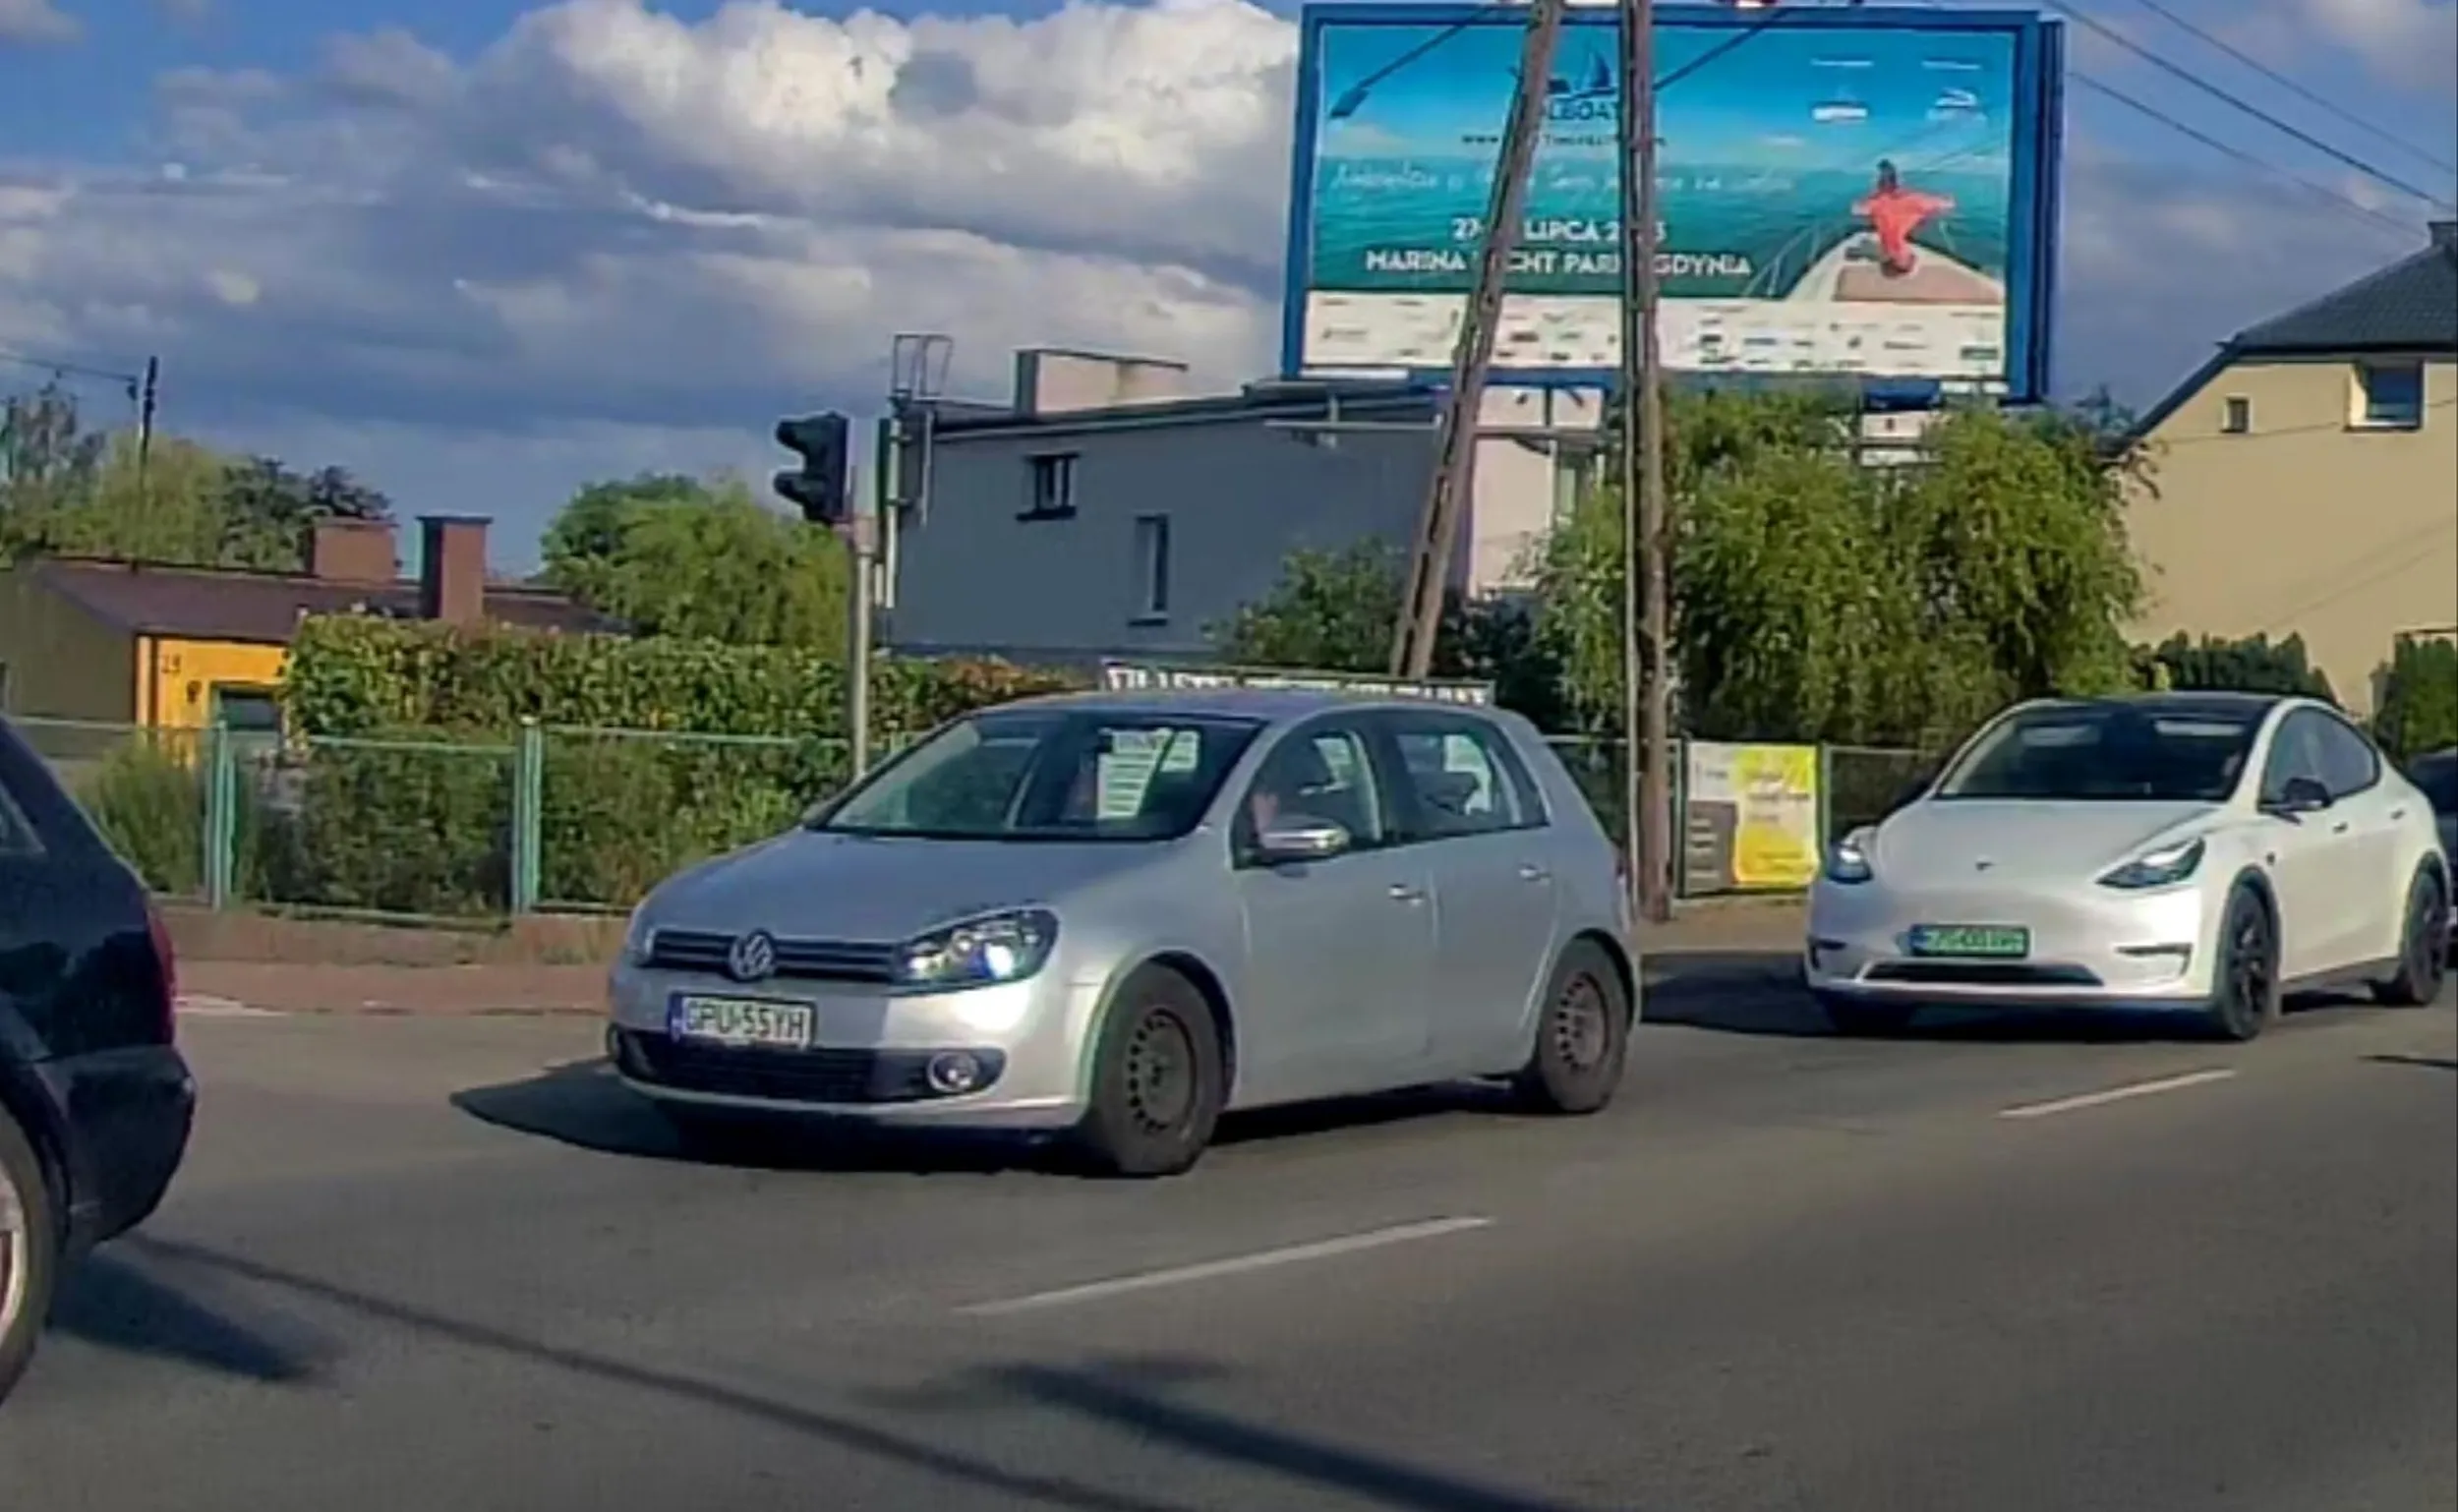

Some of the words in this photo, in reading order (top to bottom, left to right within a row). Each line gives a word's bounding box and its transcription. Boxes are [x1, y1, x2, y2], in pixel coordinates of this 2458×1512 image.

[1523, 219, 1601, 242] LIPCA
[1365, 250, 1467, 271] MARINA
[1652, 253, 1751, 277] GDYNIA
